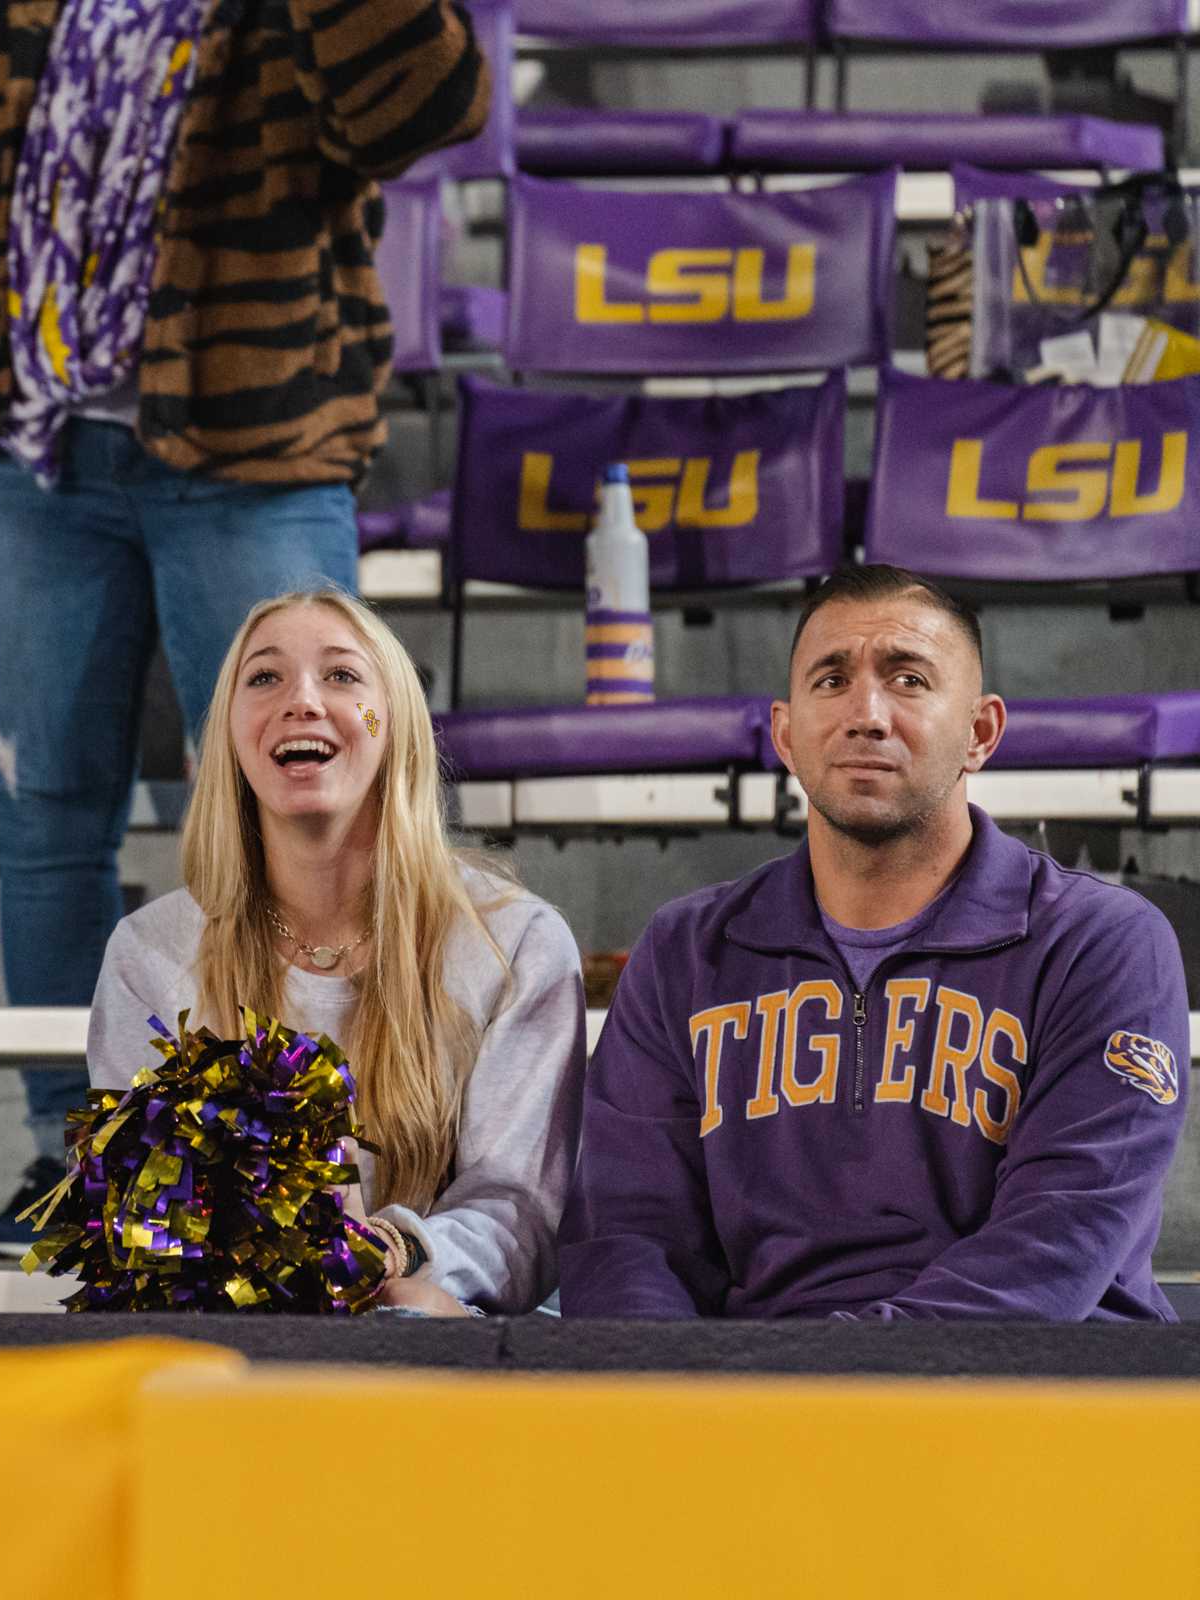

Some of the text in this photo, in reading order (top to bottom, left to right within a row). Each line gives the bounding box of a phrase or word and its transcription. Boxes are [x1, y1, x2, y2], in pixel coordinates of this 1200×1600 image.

[575, 243, 816, 324] LSU
[946, 431, 1188, 522] LSU
[689, 978, 1027, 1145] TIGERS
